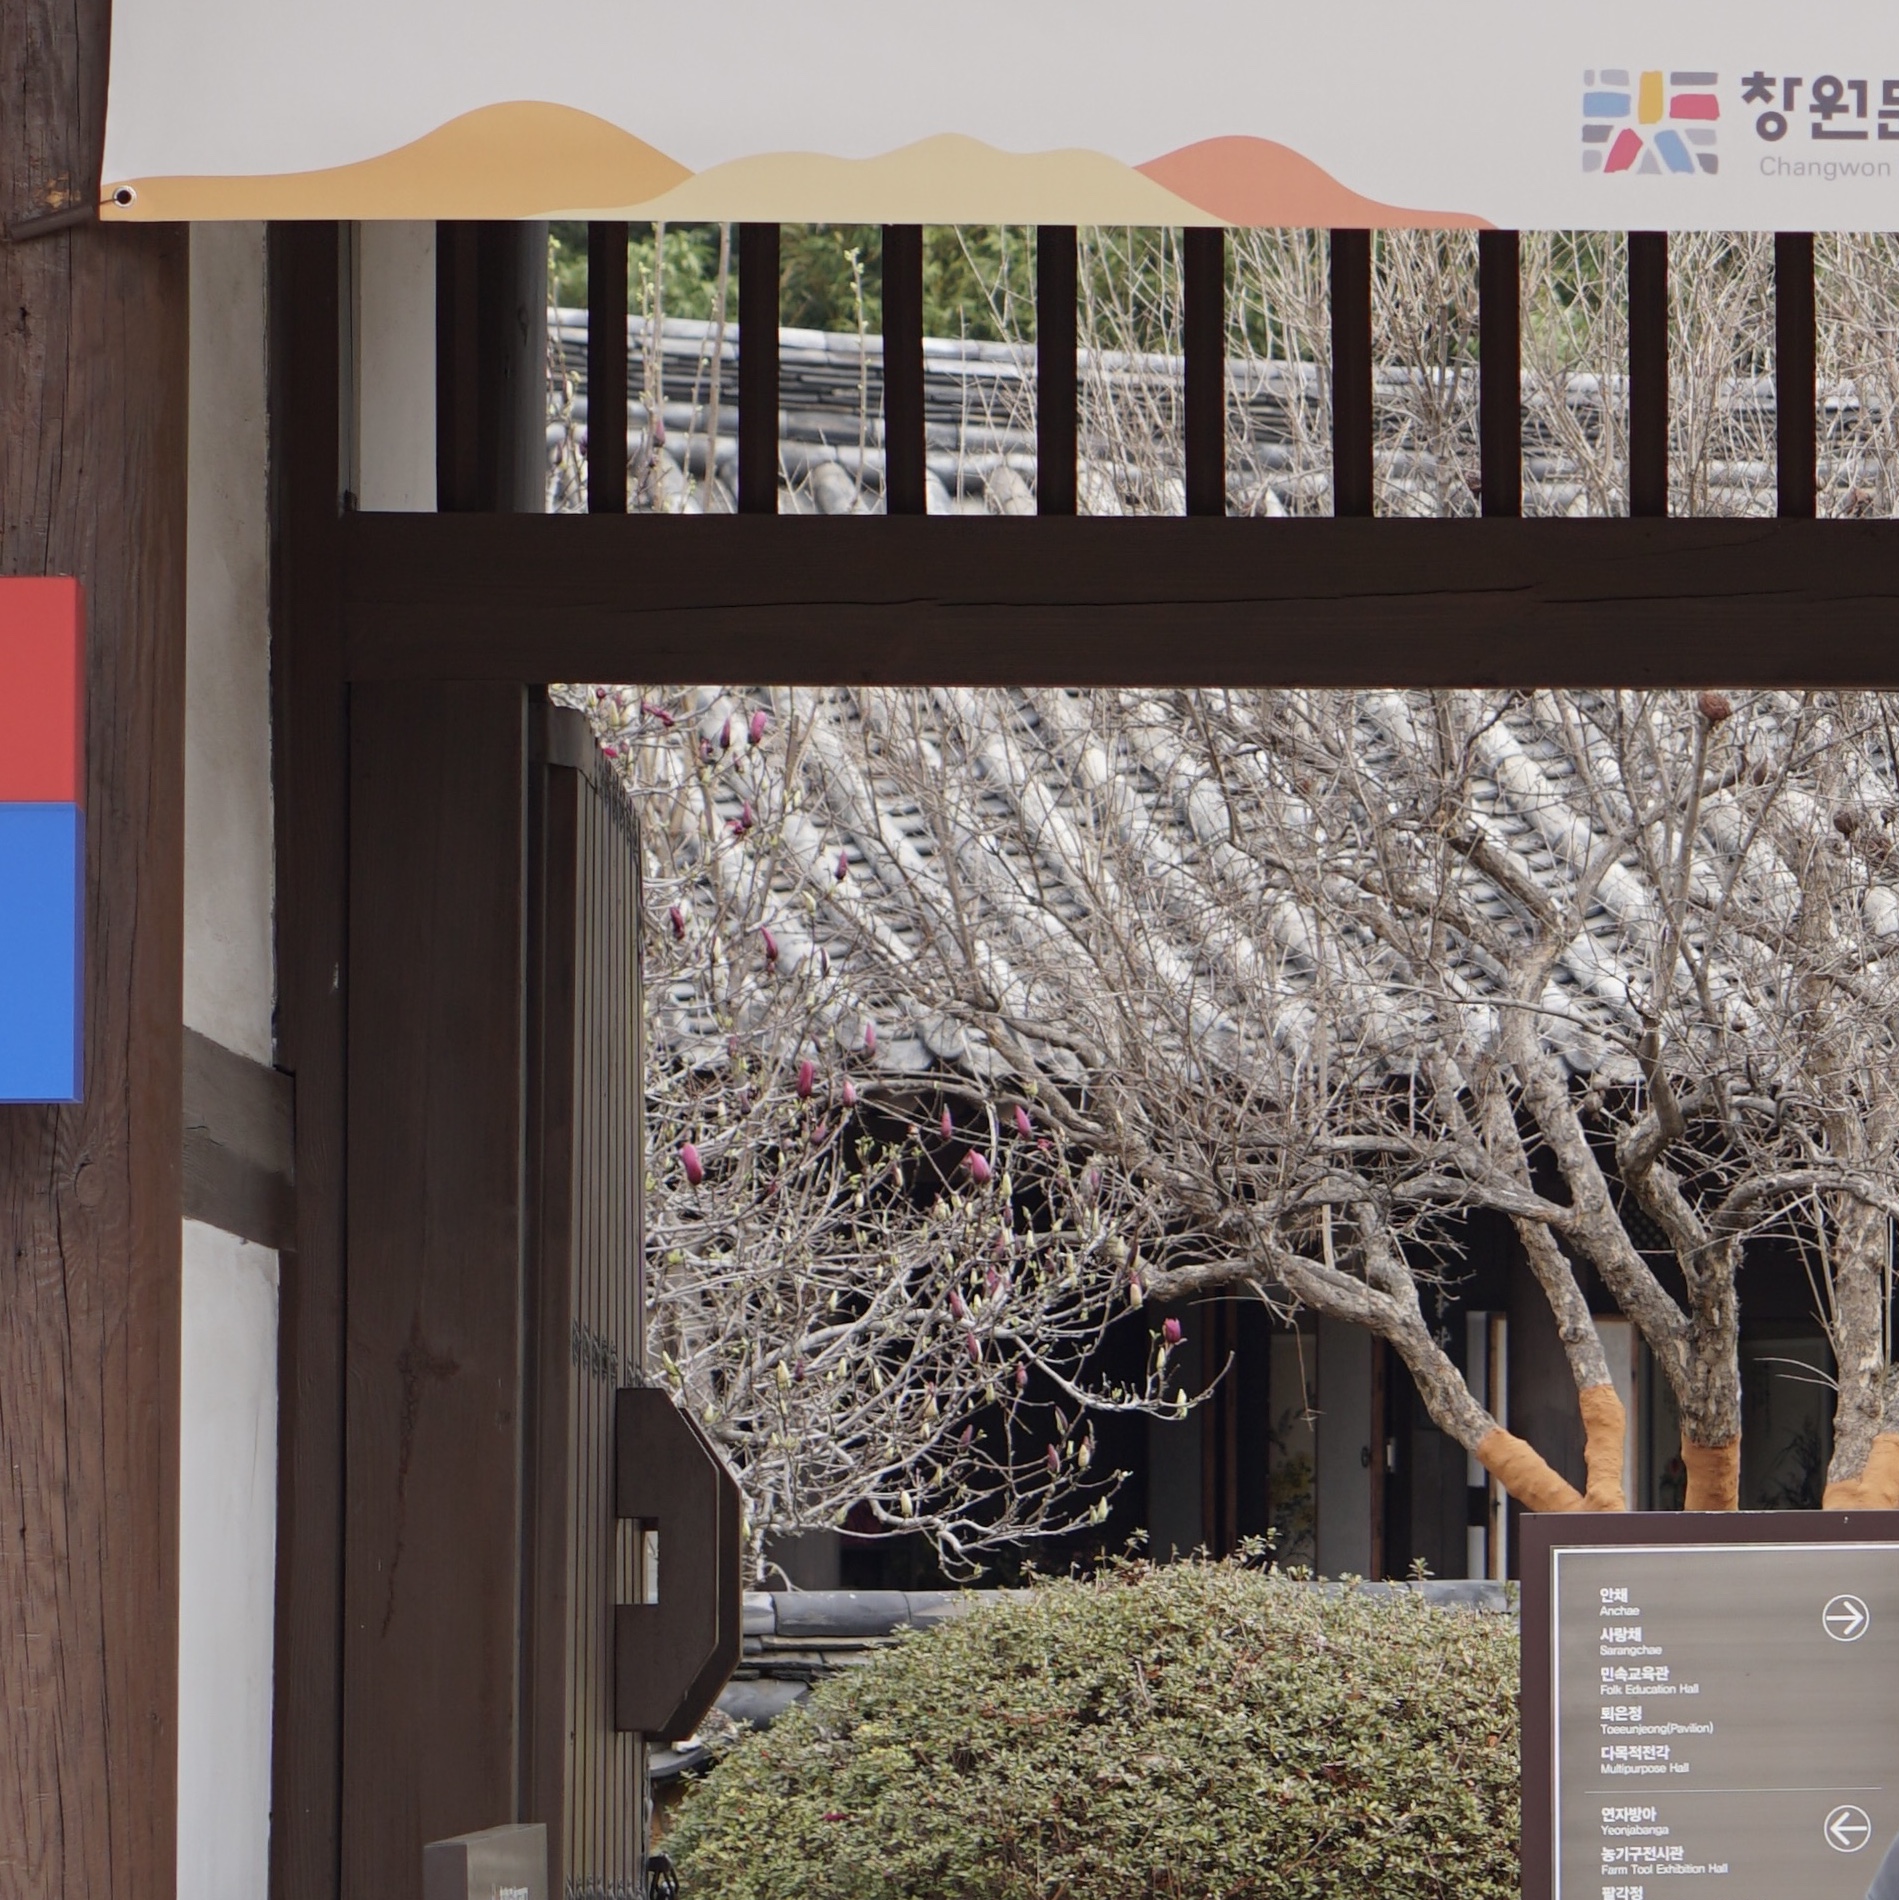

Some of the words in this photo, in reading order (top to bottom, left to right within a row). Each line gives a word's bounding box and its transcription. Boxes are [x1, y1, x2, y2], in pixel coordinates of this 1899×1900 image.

[1760, 156, 1890, 181] Changwon
[1600, 1588, 1628, 1603] 안채
[1600, 1606, 1640, 1616] Anchae
[1600, 1627, 1642, 1642] 사랑채
[1600, 1645, 1662, 1656] Sarangchae
[1601, 1666, 1670, 1682] 민속교육관
[1601, 1685, 1622, 1695] Folk
[1625, 1684, 1676, 1694] Education
[1680, 1684, 1699, 1693] Hall
[1601, 1706, 1642, 1721] 퇴은정
[1600, 1722, 1713, 1735] Toeeunjeong(Pavilion)
[1601, 1745, 1670, 1761] 다목적전각
[1601, 1764, 1667, 1775] Multipurpose
[1670, 1763, 1689, 1773] Hall
[1602, 1807, 1657, 1822] 연자방아
[1601, 1825, 1669, 1836] Yeonjabanga
[1601, 1846, 1684, 1862] 농기구전시관
[1602, 1864, 1628, 1875] Farm
[1631, 1864, 1653, 1874] Tool
[1656, 1864, 1705, 1874] Exhibition
[1708, 1863, 1728, 1873] Hall
[1602, 1886, 1643, 1900] 팔각정
